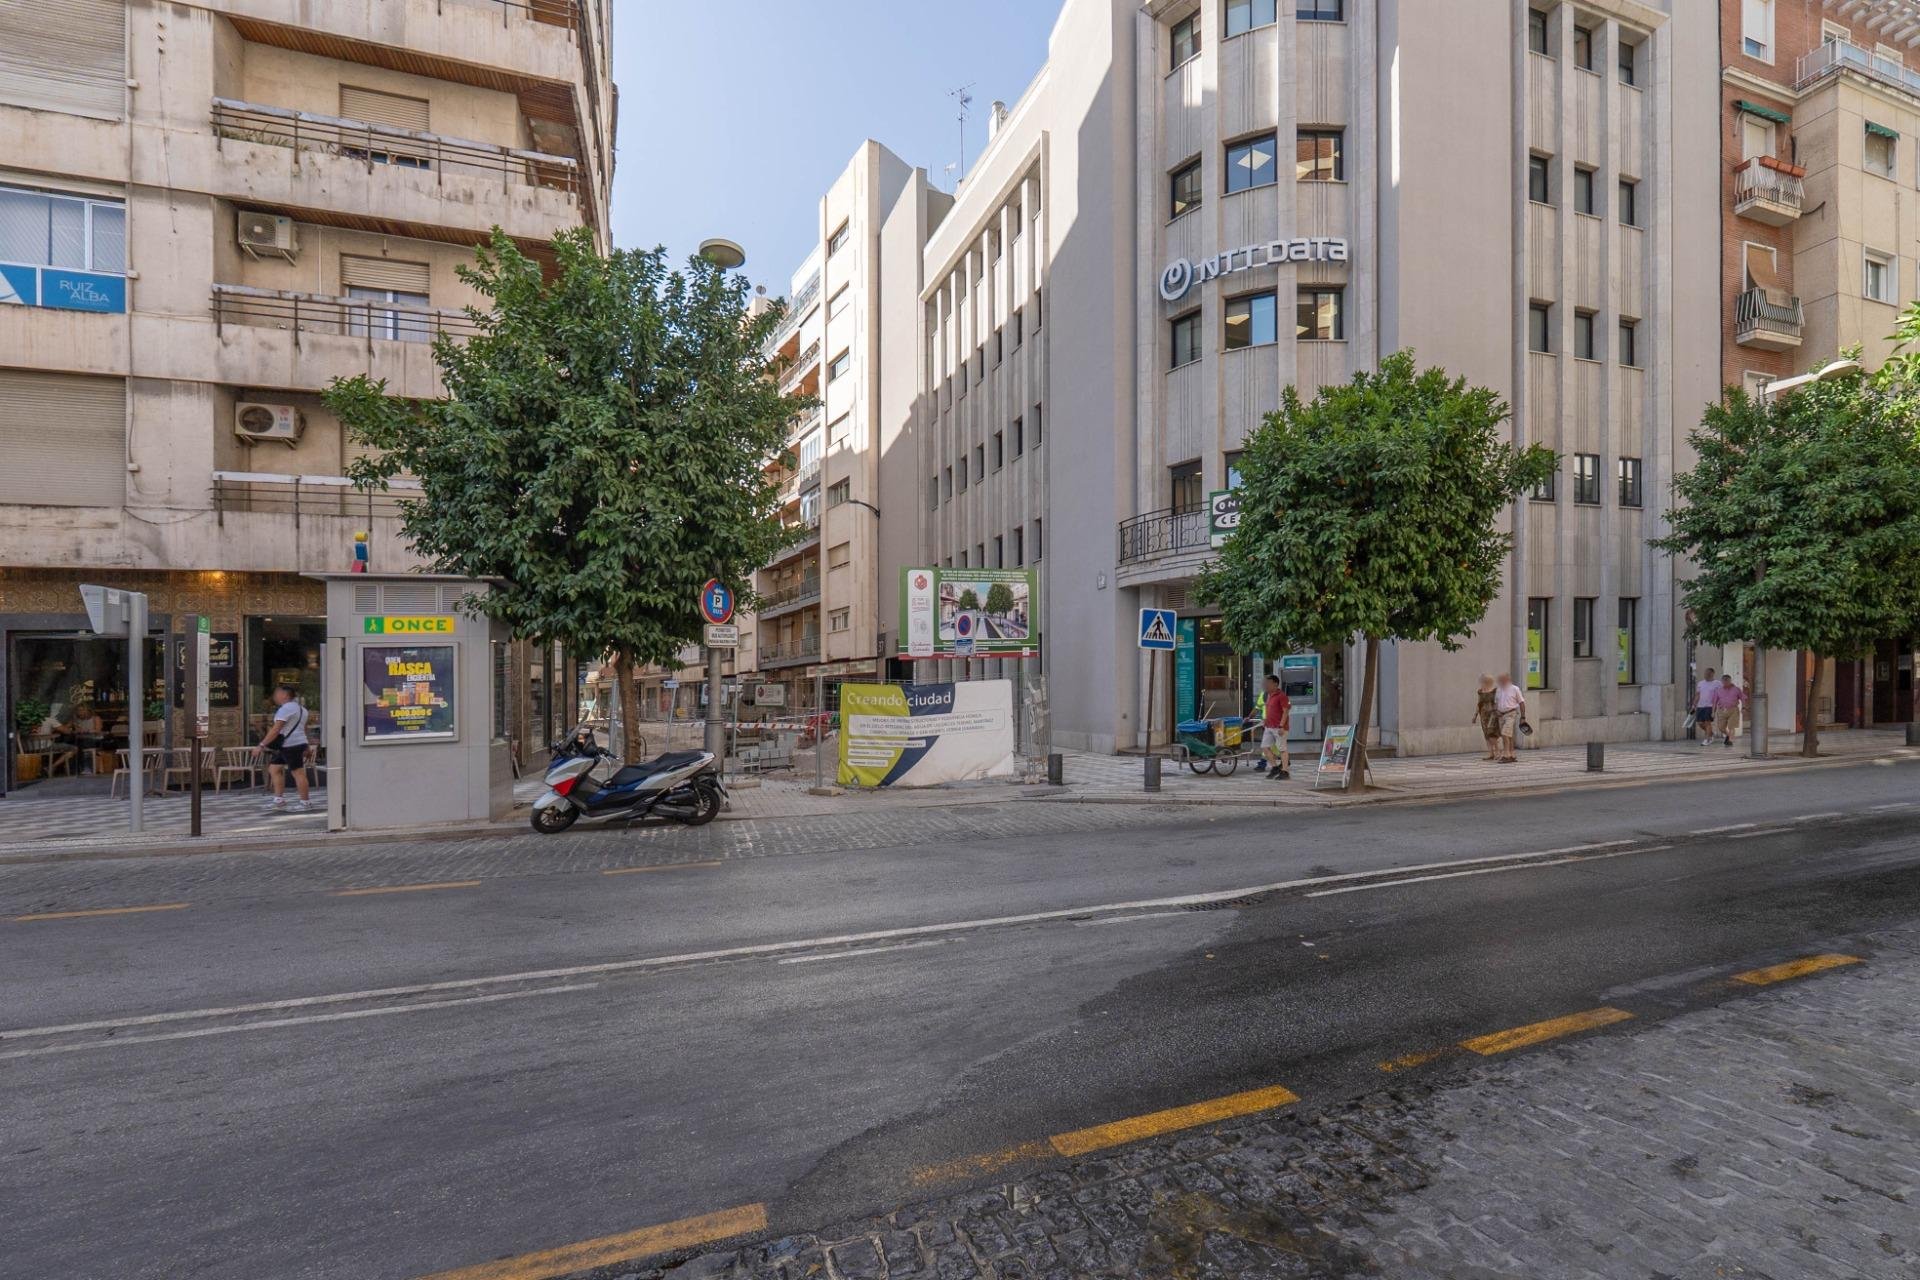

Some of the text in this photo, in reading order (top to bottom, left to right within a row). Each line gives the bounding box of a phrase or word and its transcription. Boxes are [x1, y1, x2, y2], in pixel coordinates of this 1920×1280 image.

[1201, 245, 1259, 281] NTT
[60, 280, 94, 293] RUIZ
[70, 289, 110, 302] ALBA
[715, 596, 720, 605] P
[391, 619, 447, 631] ONCE
[388, 662, 432, 676] RASCA
[847, 691, 951, 707] Creando ciudad
